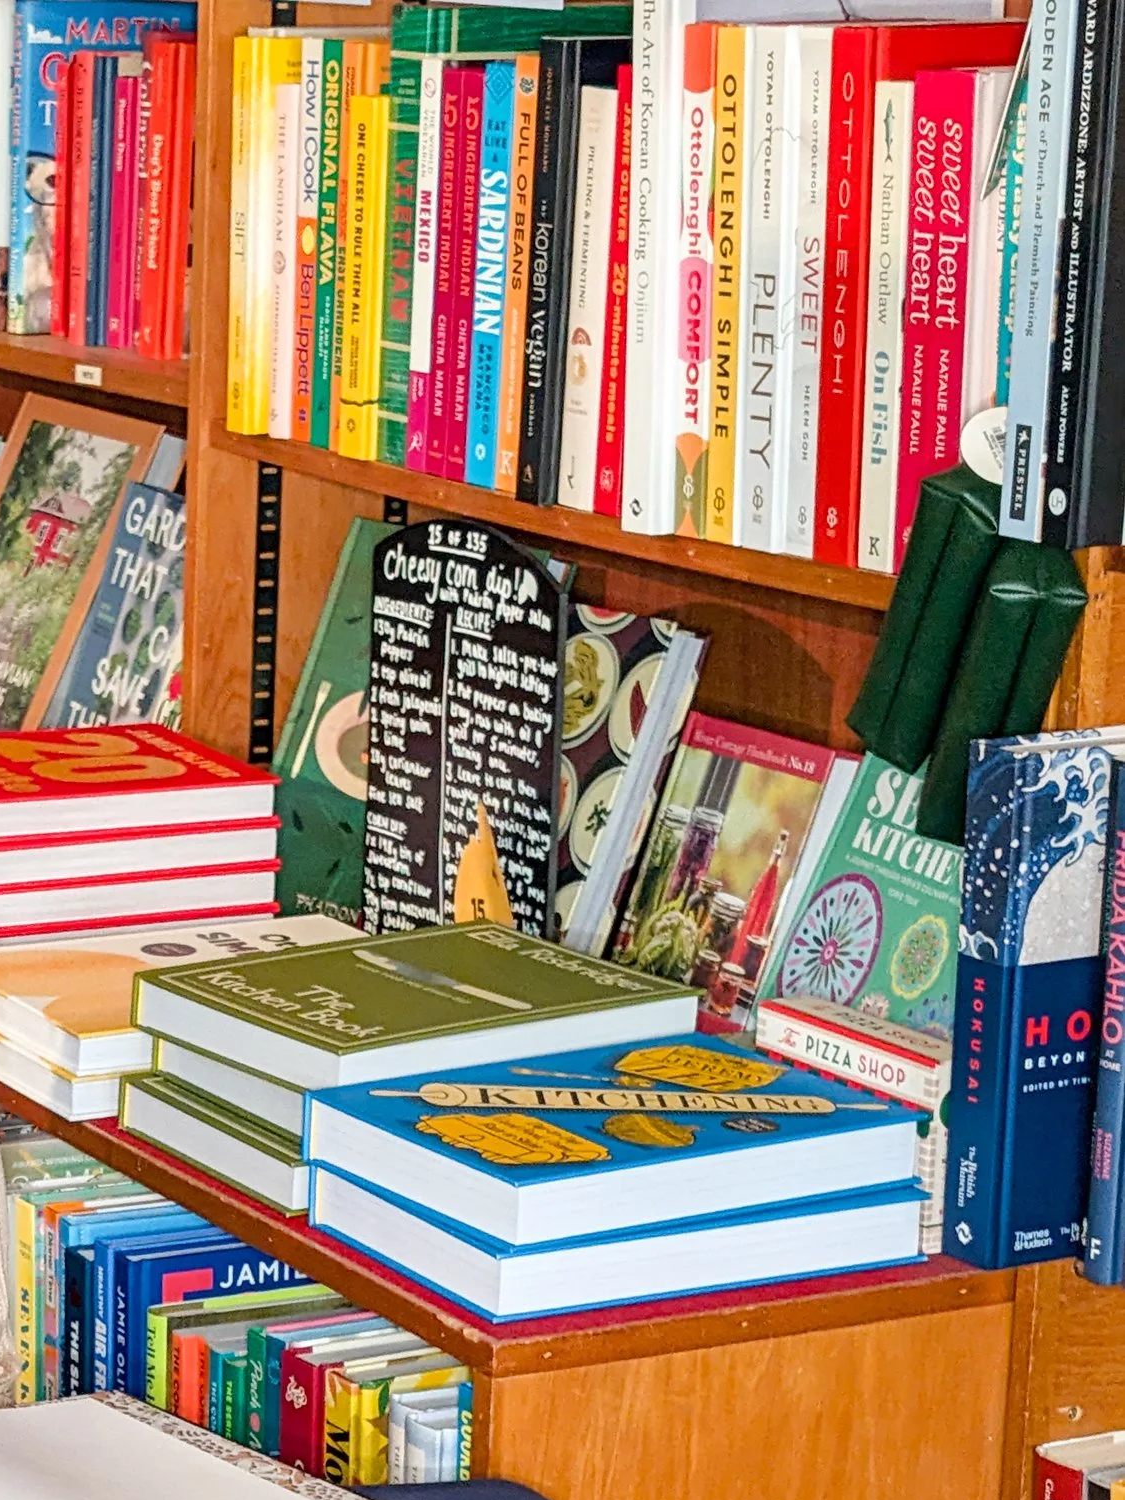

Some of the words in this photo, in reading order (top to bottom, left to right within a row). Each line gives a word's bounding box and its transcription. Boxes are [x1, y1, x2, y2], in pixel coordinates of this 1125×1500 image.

[642, 75, 654, 98] of
[643, 38, 655, 73] Art
[764, 50, 775, 106] YOTAM
[303, 60, 320, 119] How
[443, 93, 458, 128] 5
[465, 96, 480, 131] 5
[811, 70, 820, 114] YOTAM
[1038, 79, 1052, 123] AGE
[1077, 46, 1094, 155] ARDIZZONE:
[320, 60, 340, 194] ORIGINAL
[357, 123, 366, 147] ONE
[519, 112, 531, 167] FULL
[638, 101, 654, 170] Korean
[303, 137, 319, 204] Cook
[355, 153, 366, 198] CHEESE
[440, 131, 455, 232] INGREDIENT
[462, 134, 477, 238] INGREDIENT
[516, 176, 528, 206] OF
[586, 145, 595, 206] PICKLING
[685, 107, 704, 257] Ottolenghi
[718, 74, 737, 298] OTTOLENGHI
[762, 112, 774, 220] OTTOLENGHI
[810, 117, 820, 205] OTTOLENGHI
[913, 116, 937, 224] sweet
[938, 118, 964, 227] sweet
[1035, 145, 1047, 185] Dutch
[1072, 157, 1088, 220] ARTIST
[418, 190, 432, 263] MEXICO
[616, 171, 630, 244] OLIVER
[634, 177, 652, 261] Cooking
[832, 71, 855, 395] OTTOLENGHI
[880, 174, 893, 245] Nathan
[1069, 222, 1082, 250] AND
[318, 201, 336, 286] FLAVA
[353, 227, 363, 258] RULE
[390, 160, 414, 321] VIETNAM
[438, 234, 452, 293] INDIAN
[460, 240, 474, 297] INDIAN
[473, 168, 508, 335] SARDINIAN
[511, 211, 526, 290] BEANS
[532, 222, 554, 301] korean
[299, 263, 315, 309] Ben
[352, 262, 362, 298] THEM
[801, 236, 820, 354] SWEET
[877, 253, 892, 325] Outlaw
[910, 229, 935, 326] heart
[934, 231, 966, 331] heart
[351, 304, 360, 325] ALL
[435, 314, 447, 365] CHETNA
[609, 261, 626, 378] 20-minute
[1025, 281, 1039, 337] Painting
[1061, 251, 1082, 373] ILLUSTRATOR
[295, 313, 313, 396] Lippett
[456, 319, 468, 370] CHETNA
[526, 310, 548, 389] vegan
[684, 269, 702, 425] COMFORT
[749, 272, 776, 470] PLENTY
[873, 351, 890, 394] On
[433, 370, 444, 417] MAKAN
[454, 374, 466, 422] MAKAN
[714, 318, 732, 439] SIMPLE
[802, 384, 812, 427] HELEN
[911, 344, 923, 408] NATALIE
[936, 348, 949, 412] NATALIE
[605, 382, 617, 444] meals
[870, 402, 888, 466] Fish
[909, 410, 922, 454] PAULL
[934, 413, 948, 460] PAULL
[1014, 449, 1028, 511] PRESTEL
[110, 547, 169, 603] THAT
[91, 656, 150, 718] SAVE
[470, 898, 486, 920] 15
[197, 970, 302, 1013] Kitchen
[297, 1009, 387, 1039] Book
[295, 984, 356, 1011] The
[1102, 931, 1125, 1046] KAHLO
[805, 1035, 852, 1070] PIZZA
[857, 1055, 906, 1087] SHOP
[967, 977, 986, 1104] HOKUSAI
[477, 1086, 819, 1114] KITCHENING
[69, 1320, 80, 1358] THE
[94, 1318, 107, 1354] AIR
[116, 1286, 126, 1346] JAMIE
[249, 1358, 264, 1409] Pinch
